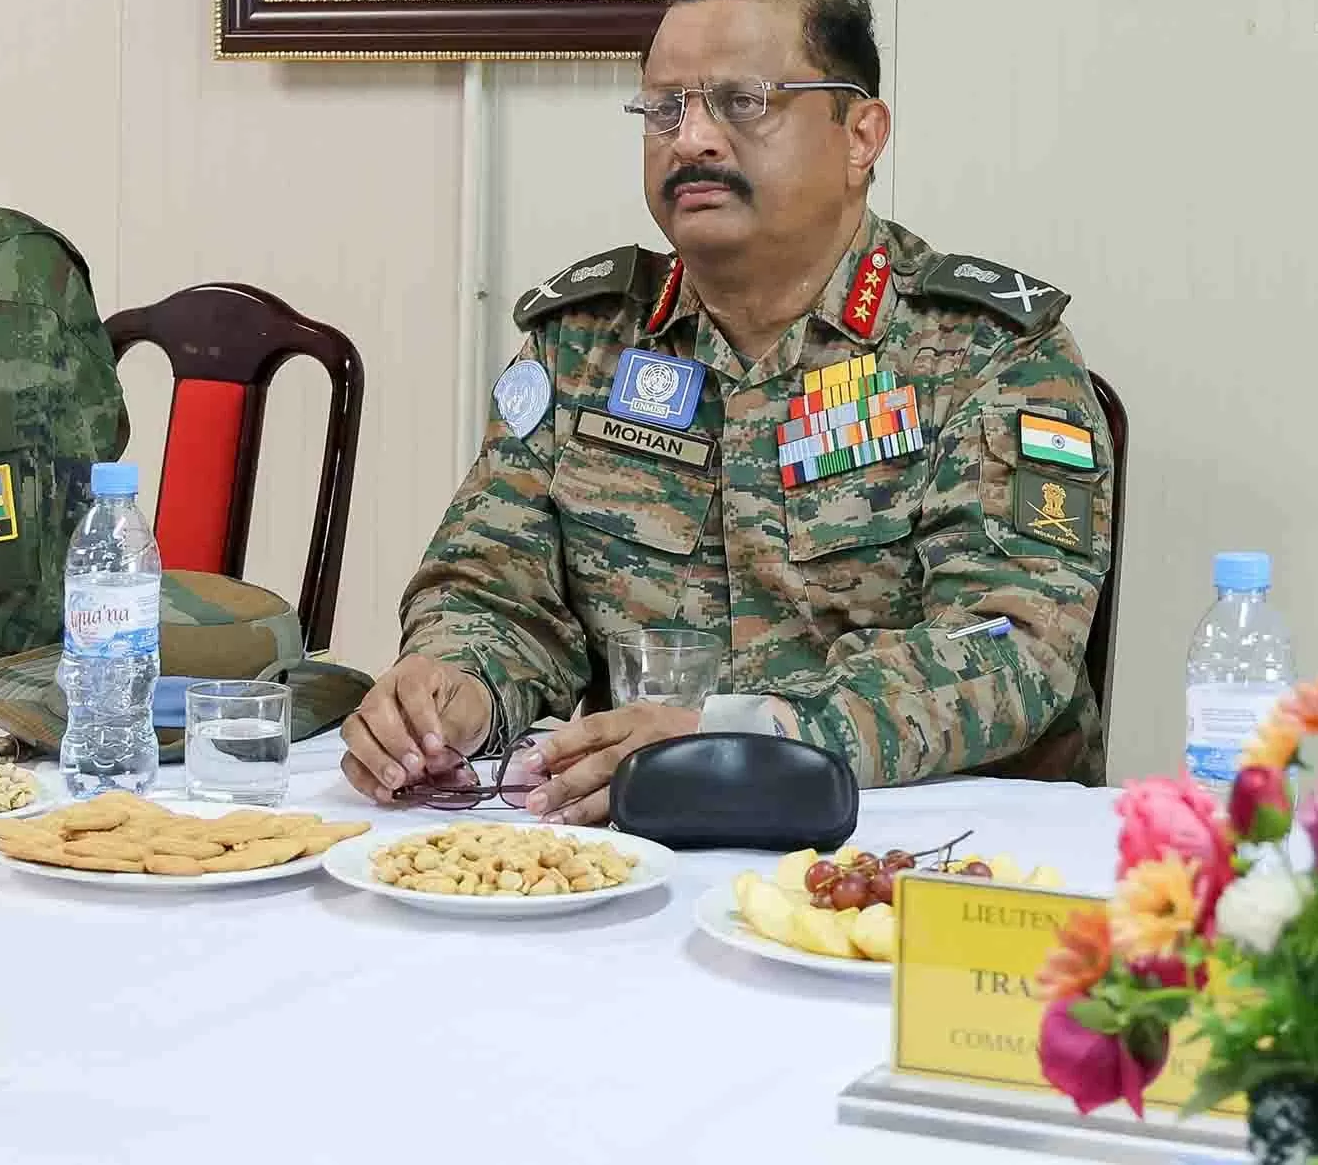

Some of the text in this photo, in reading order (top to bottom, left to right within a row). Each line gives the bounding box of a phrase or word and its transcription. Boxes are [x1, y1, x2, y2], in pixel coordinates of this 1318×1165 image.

[633, 401, 666, 416] UNMISS
[602, 421, 683, 456] MOHAN
[961, 902, 1059, 931] LIEUTEN
[969, 967, 1032, 998] TRA
